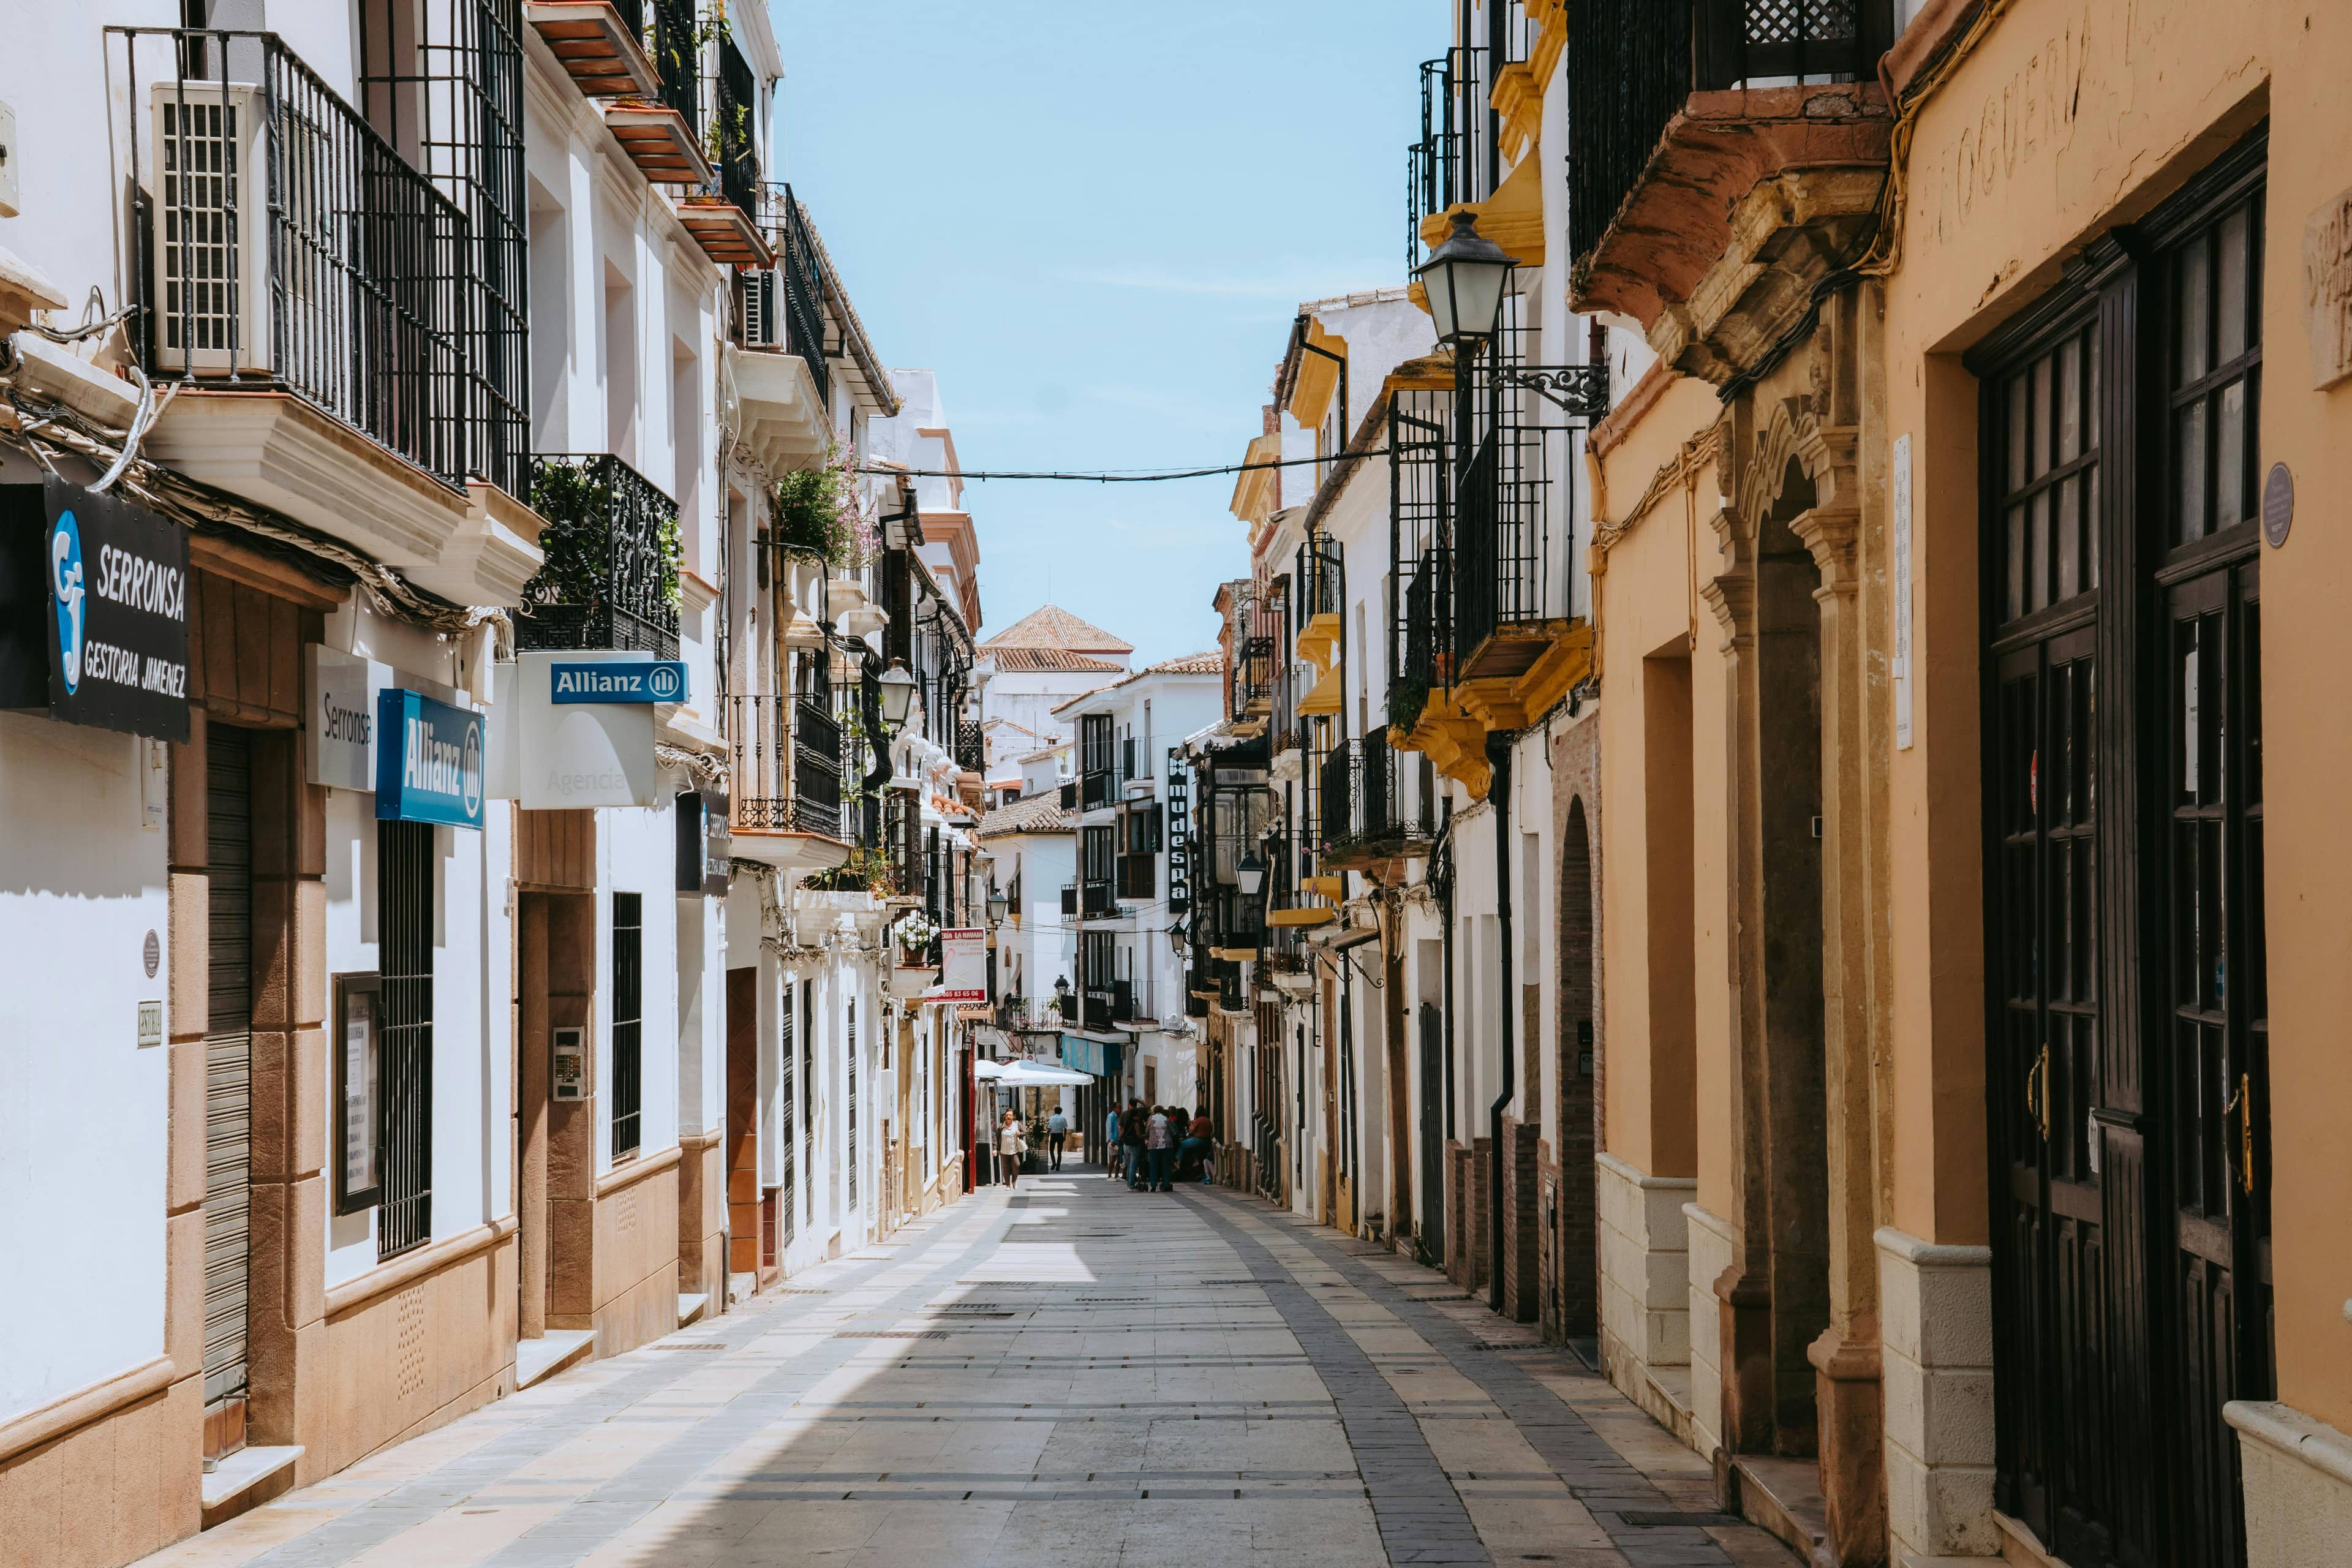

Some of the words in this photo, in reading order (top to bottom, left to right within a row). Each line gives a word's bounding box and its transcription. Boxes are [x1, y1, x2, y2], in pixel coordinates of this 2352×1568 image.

[97, 543, 184, 622] SERRONSA
[85, 640, 138, 687] GESTORIA
[141, 657, 185, 698] JIMENEZ
[556, 671, 642, 692] Allianz
[325, 692, 371, 745] Serronsa
[404, 718, 461, 796] Allianz
[546, 768, 625, 795] Agencia
[1169, 785, 1186, 899] mudespa
